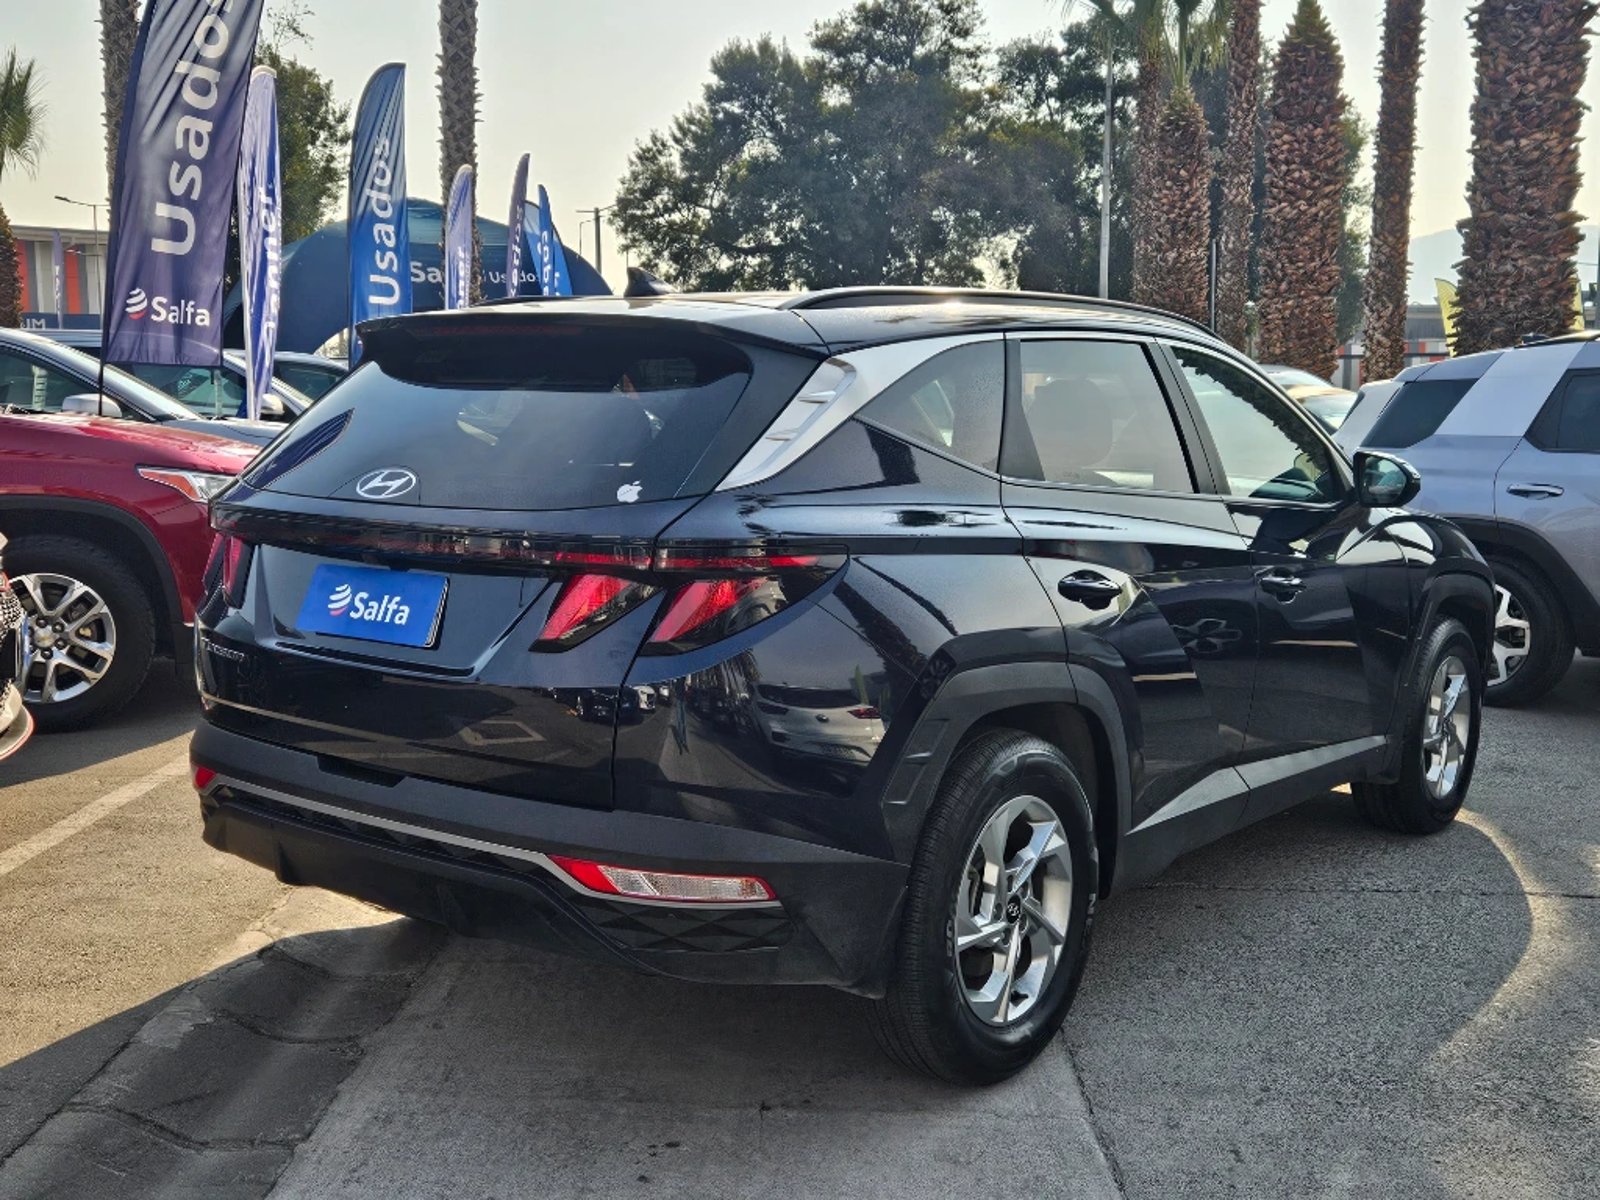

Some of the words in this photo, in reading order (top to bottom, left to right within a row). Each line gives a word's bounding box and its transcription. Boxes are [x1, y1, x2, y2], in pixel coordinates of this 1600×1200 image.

[365, 138, 401, 306] Usados
[151, 296, 210, 327] Salfa
[349, 591, 411, 626] Salfa
